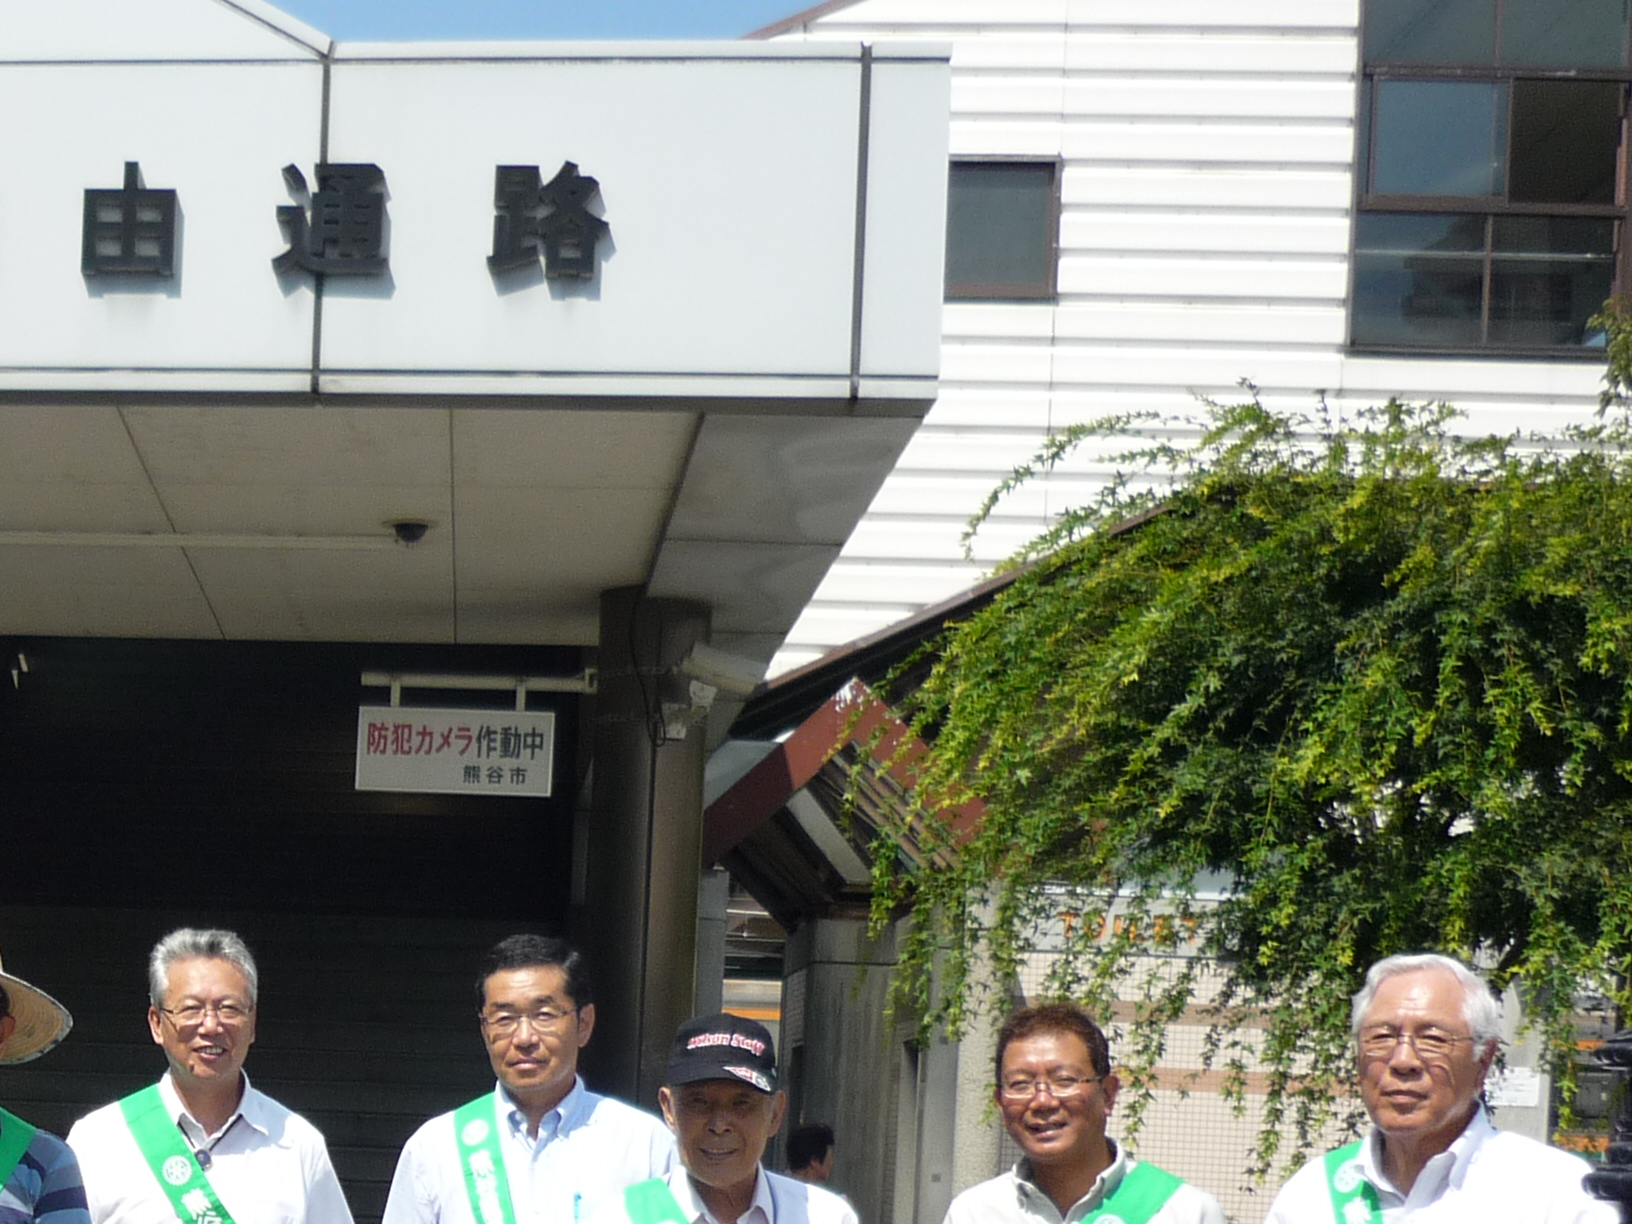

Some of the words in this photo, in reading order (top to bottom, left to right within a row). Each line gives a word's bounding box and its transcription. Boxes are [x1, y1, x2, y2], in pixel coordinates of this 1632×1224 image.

[366, 721, 545, 761] 防犯カメラ作動中
[461, 764, 529, 786] 熊谷市
